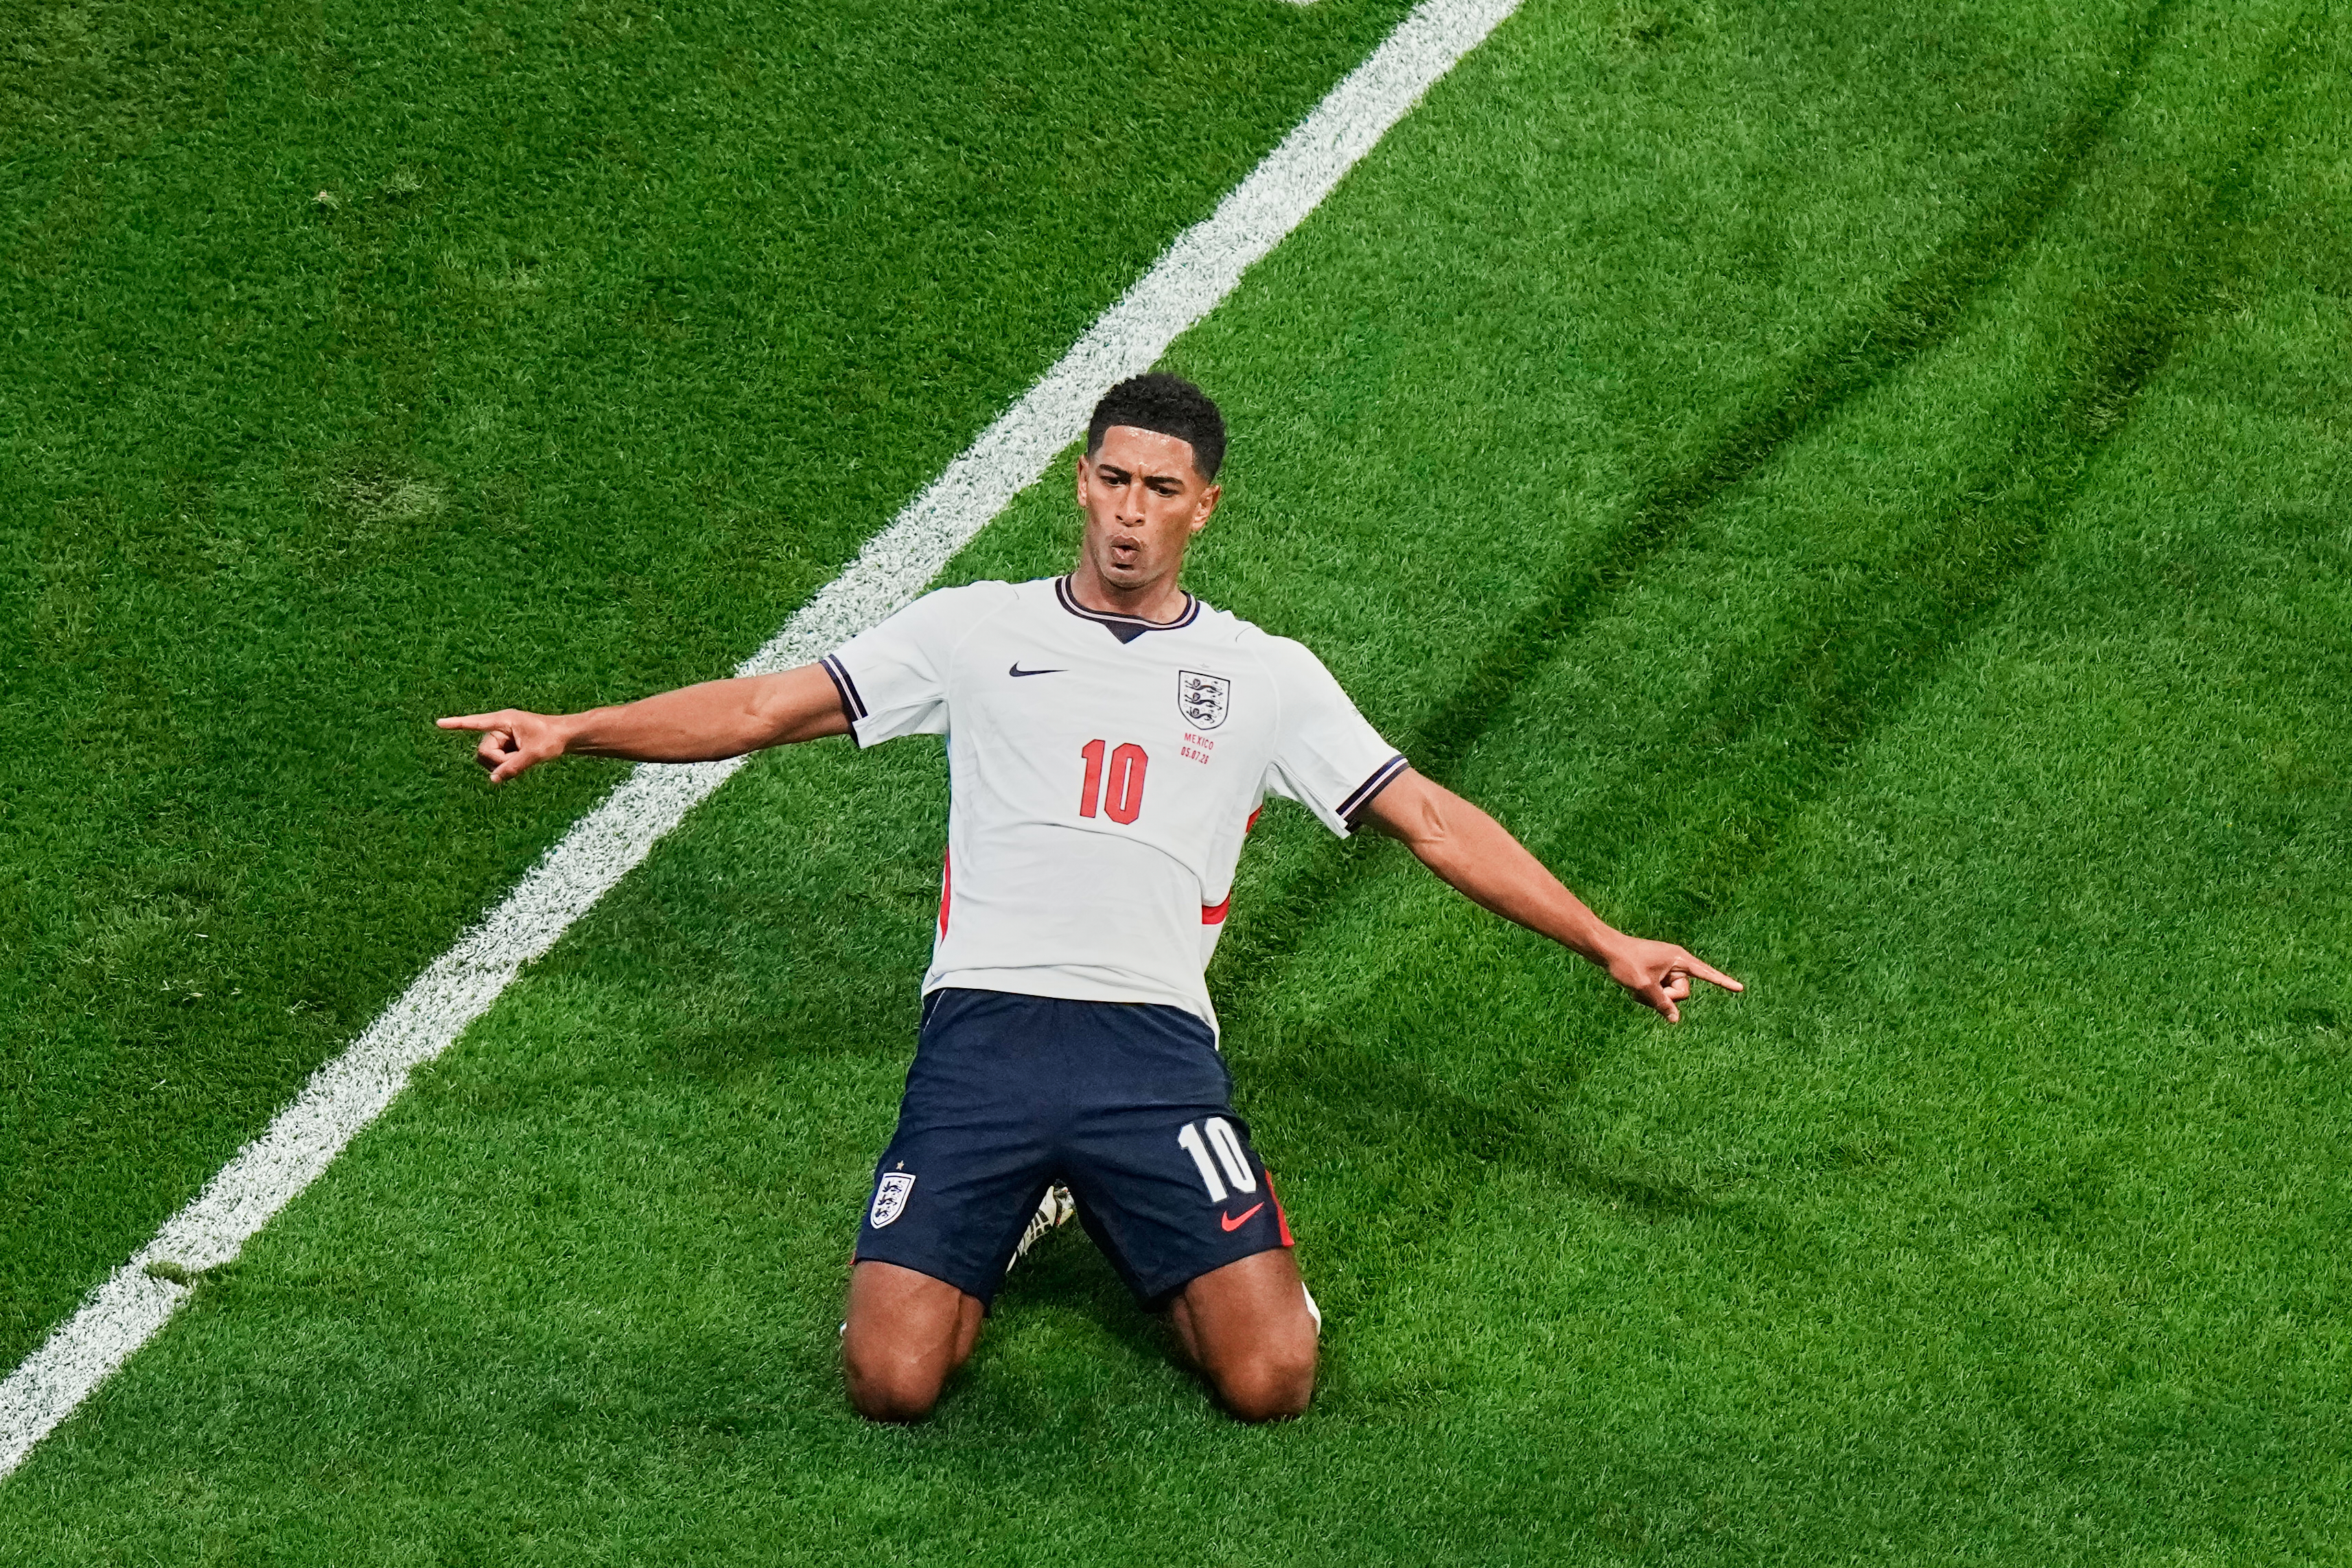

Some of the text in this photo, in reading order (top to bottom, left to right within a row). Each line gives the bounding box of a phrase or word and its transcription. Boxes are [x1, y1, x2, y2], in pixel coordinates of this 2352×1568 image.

[1180, 746, 1209, 764] 05.07.26
[1185, 732, 1214, 750] MEXICO
[1080, 739, 1148, 825] 10
[1178, 1116, 1257, 1203] 10
